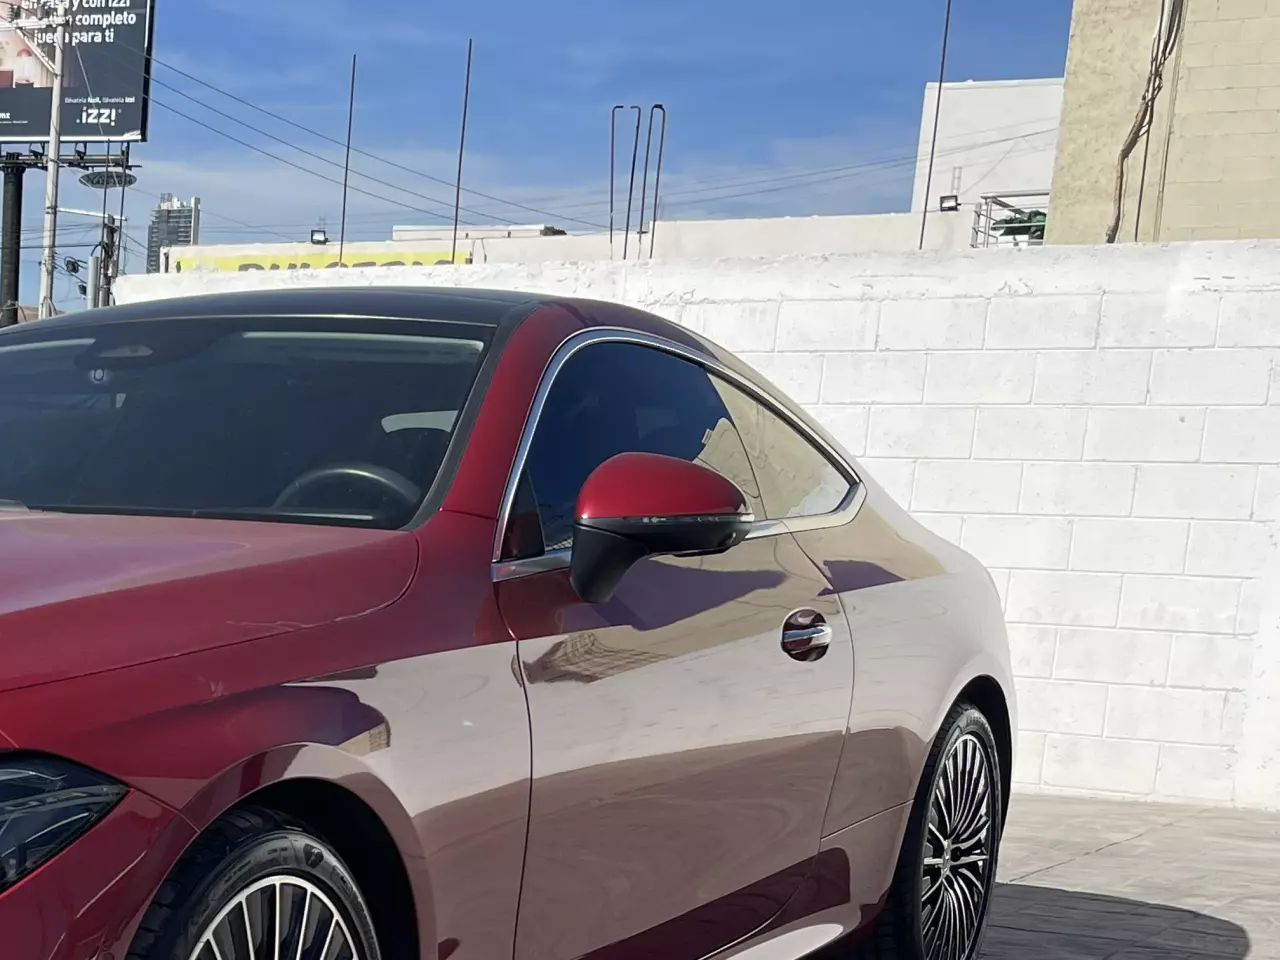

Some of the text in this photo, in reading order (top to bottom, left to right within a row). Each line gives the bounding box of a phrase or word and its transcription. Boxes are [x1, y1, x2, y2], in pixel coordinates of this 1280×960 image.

[75, 11, 137, 28] completo
[72, 31, 102, 47] para
[104, 28, 115, 43] ti
